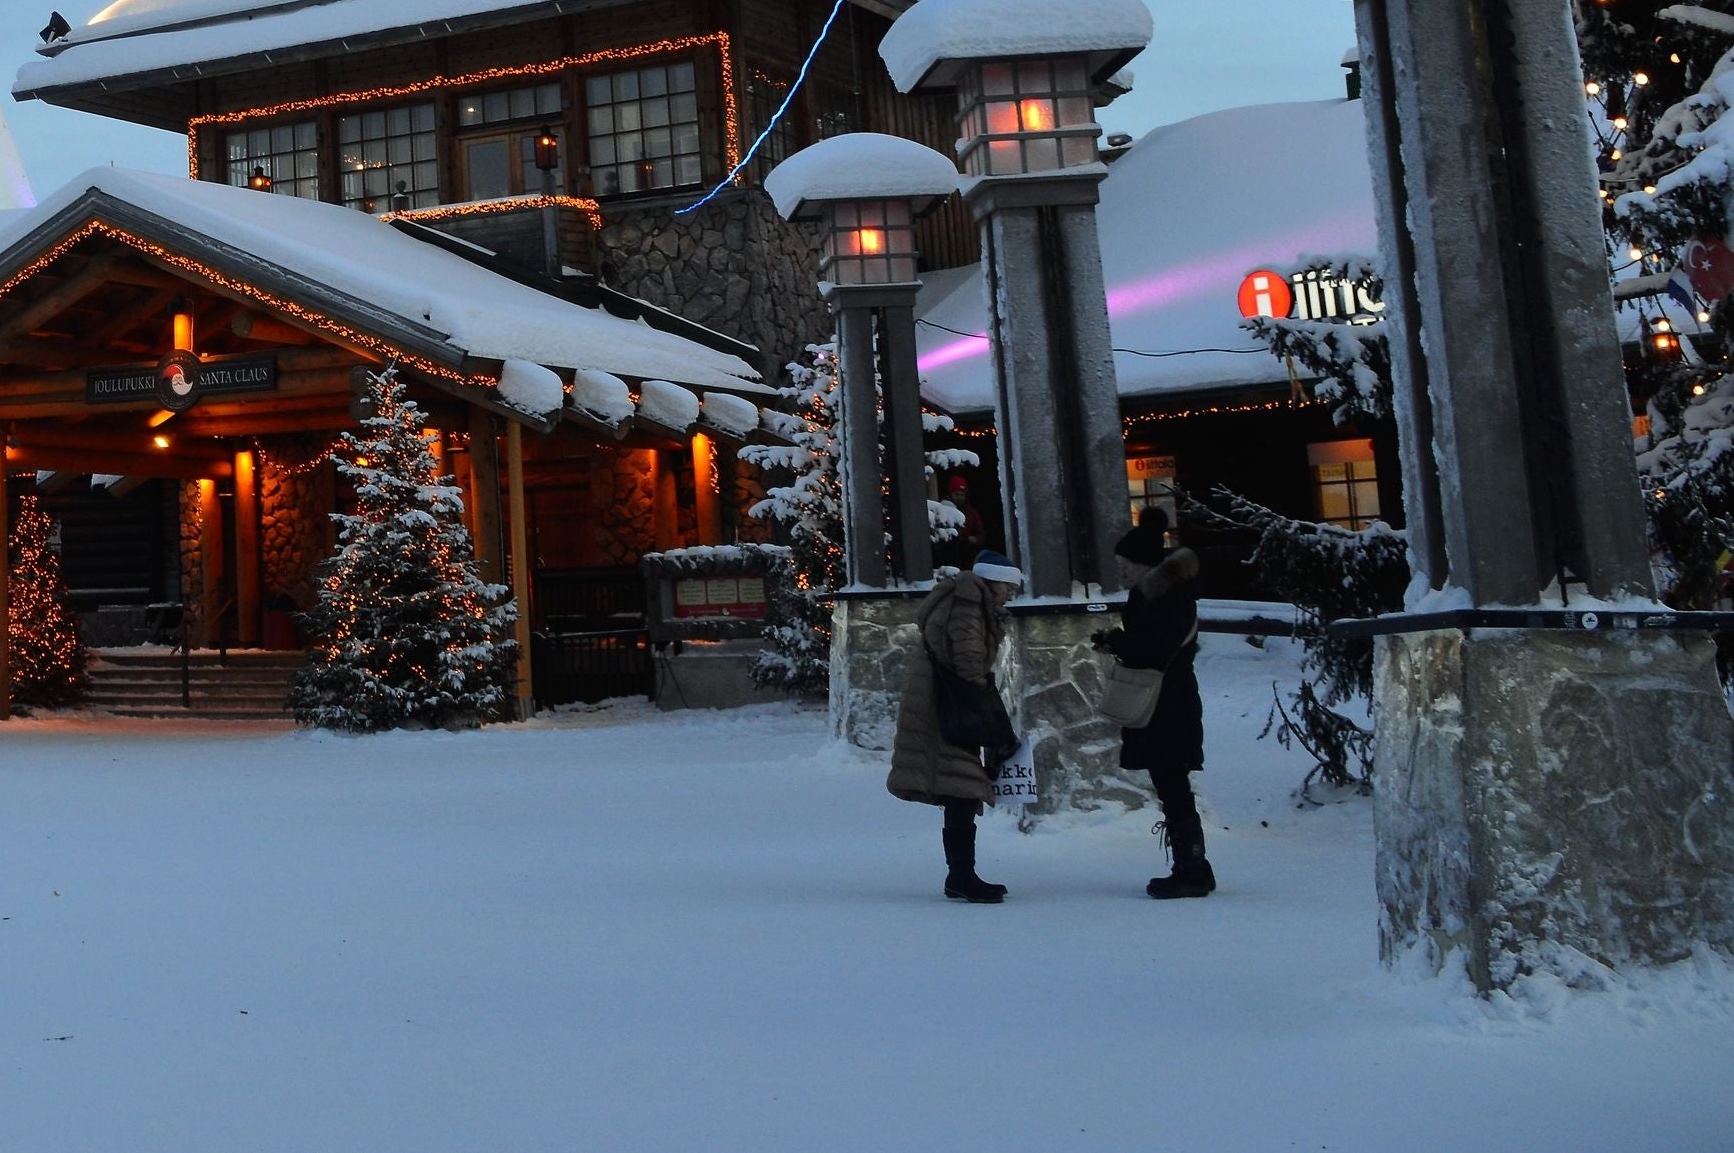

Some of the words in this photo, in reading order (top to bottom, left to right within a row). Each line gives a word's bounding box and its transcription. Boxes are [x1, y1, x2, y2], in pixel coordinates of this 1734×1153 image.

[94, 376, 156, 394] JOULUPUKKI
[199, 370, 233, 386] SANTA
[234, 367, 269, 383] CLAUS
